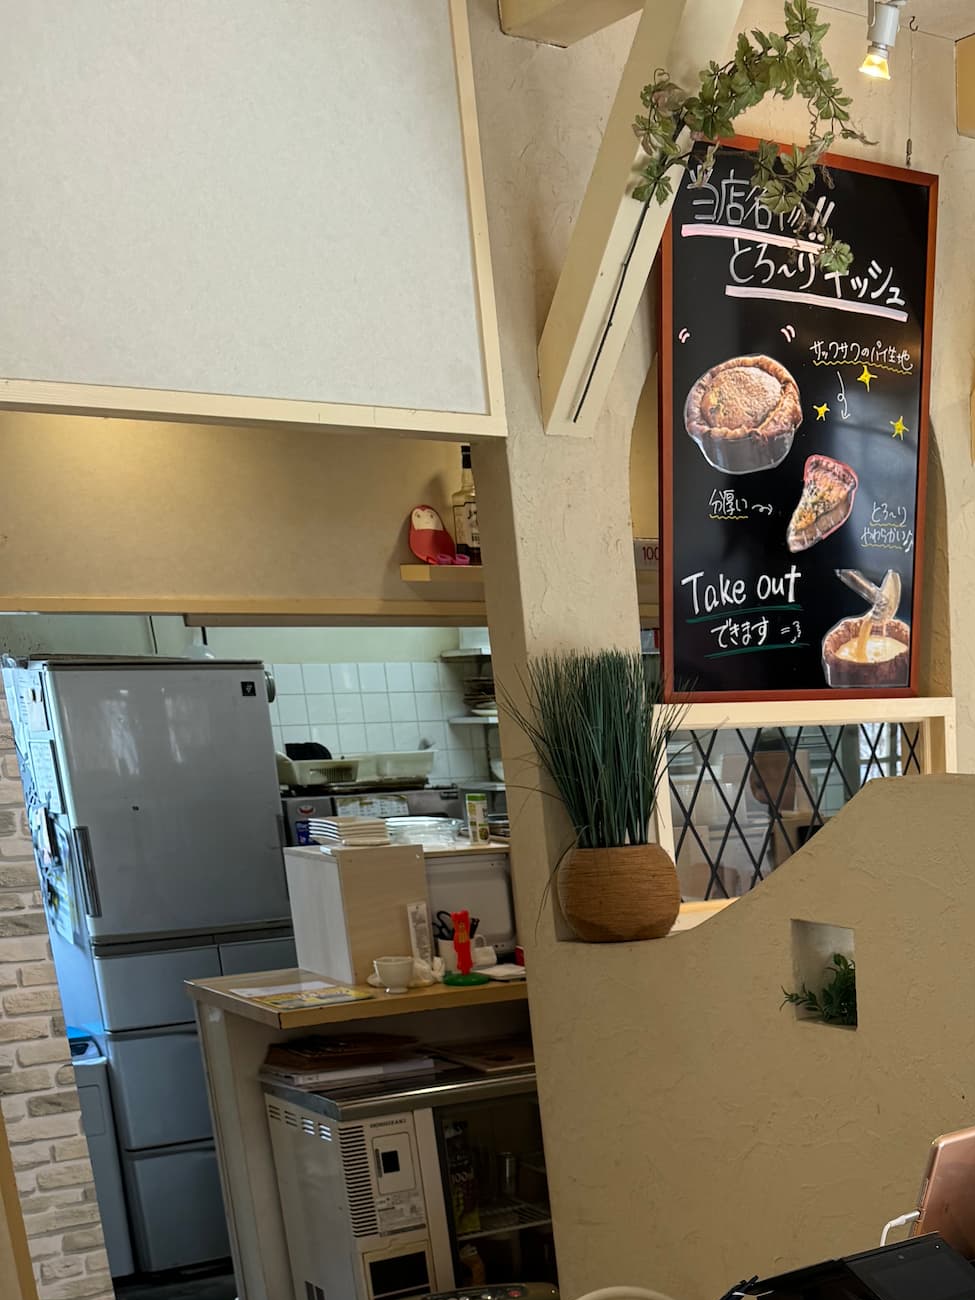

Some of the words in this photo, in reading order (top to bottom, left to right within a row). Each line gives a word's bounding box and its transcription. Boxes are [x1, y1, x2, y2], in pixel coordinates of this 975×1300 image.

[681, 570, 746, 616] Take
[756, 564, 802, 604] out
[710, 617, 770, 650] できます
